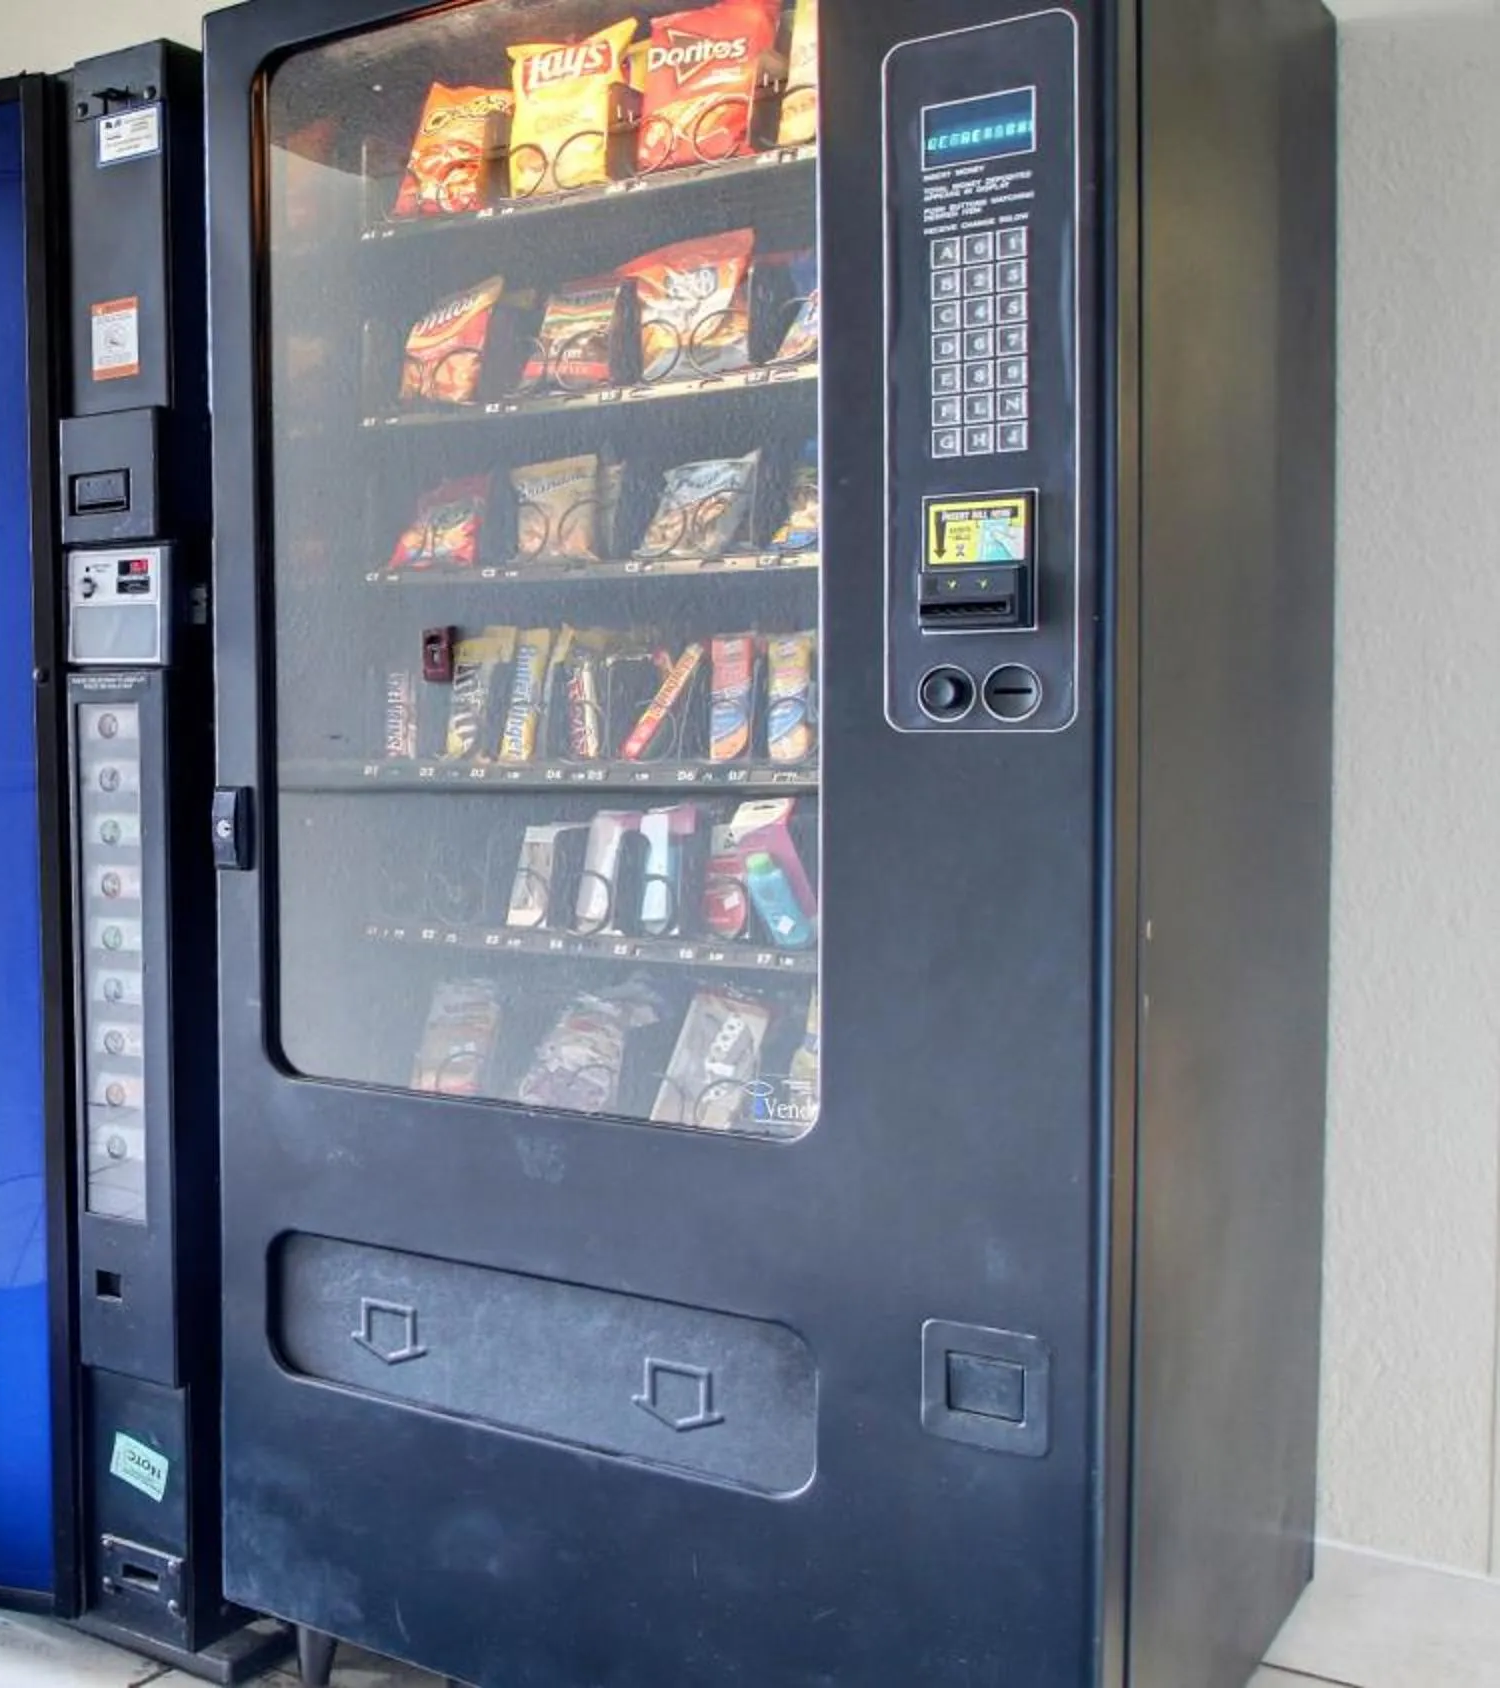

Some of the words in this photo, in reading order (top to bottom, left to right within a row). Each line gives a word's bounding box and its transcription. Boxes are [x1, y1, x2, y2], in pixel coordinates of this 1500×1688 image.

[647, 37, 748, 73] Doritos
[940, 248, 952, 259] A
[1008, 237, 1016, 249] 1
[973, 274, 984, 286] 2
[940, 309, 952, 323] C
[975, 306, 984, 318] 4
[941, 342, 953, 354] D
[974, 338, 984, 351] 6
[1007, 333, 1018, 346] 7
[941, 373, 952, 386] E
[974, 370, 984, 383] 8
[1008, 366, 1018, 379] 9
[974, 402, 986, 414] L
[1005, 397, 1019, 411] N
[940, 437, 953, 449] G
[972, 433, 986, 446] H
